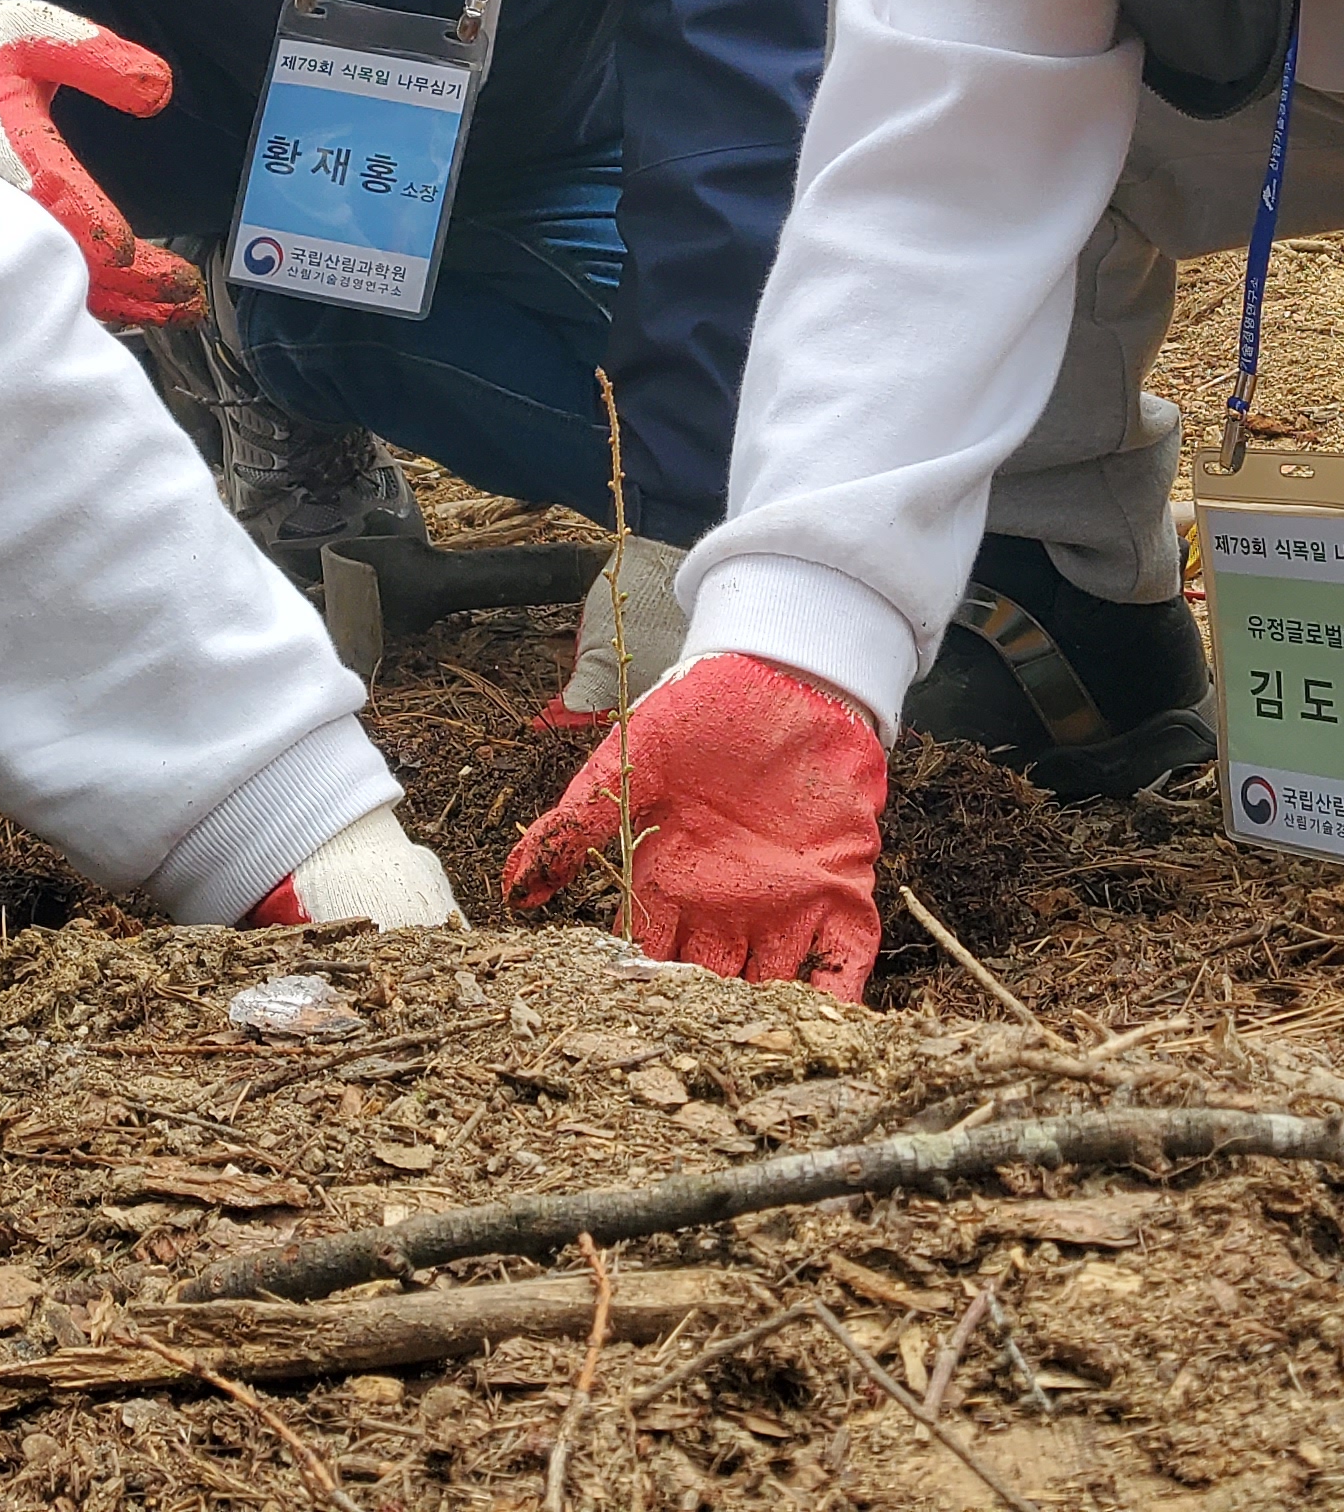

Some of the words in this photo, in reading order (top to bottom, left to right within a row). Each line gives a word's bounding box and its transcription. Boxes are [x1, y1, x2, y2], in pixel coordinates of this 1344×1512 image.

[280, 54, 334, 76] 제79회
[341, 63, 391, 86] 식목일
[397, 73, 462, 100] 나무심기
[400, 182, 439, 204] 소장
[290, 247, 407, 283] 국립산림과학원
[286, 266, 403, 298] 산림기술경영연구소
[1214, 533, 1268, 559] 제79회
[1274, 538, 1328, 563] 식목일
